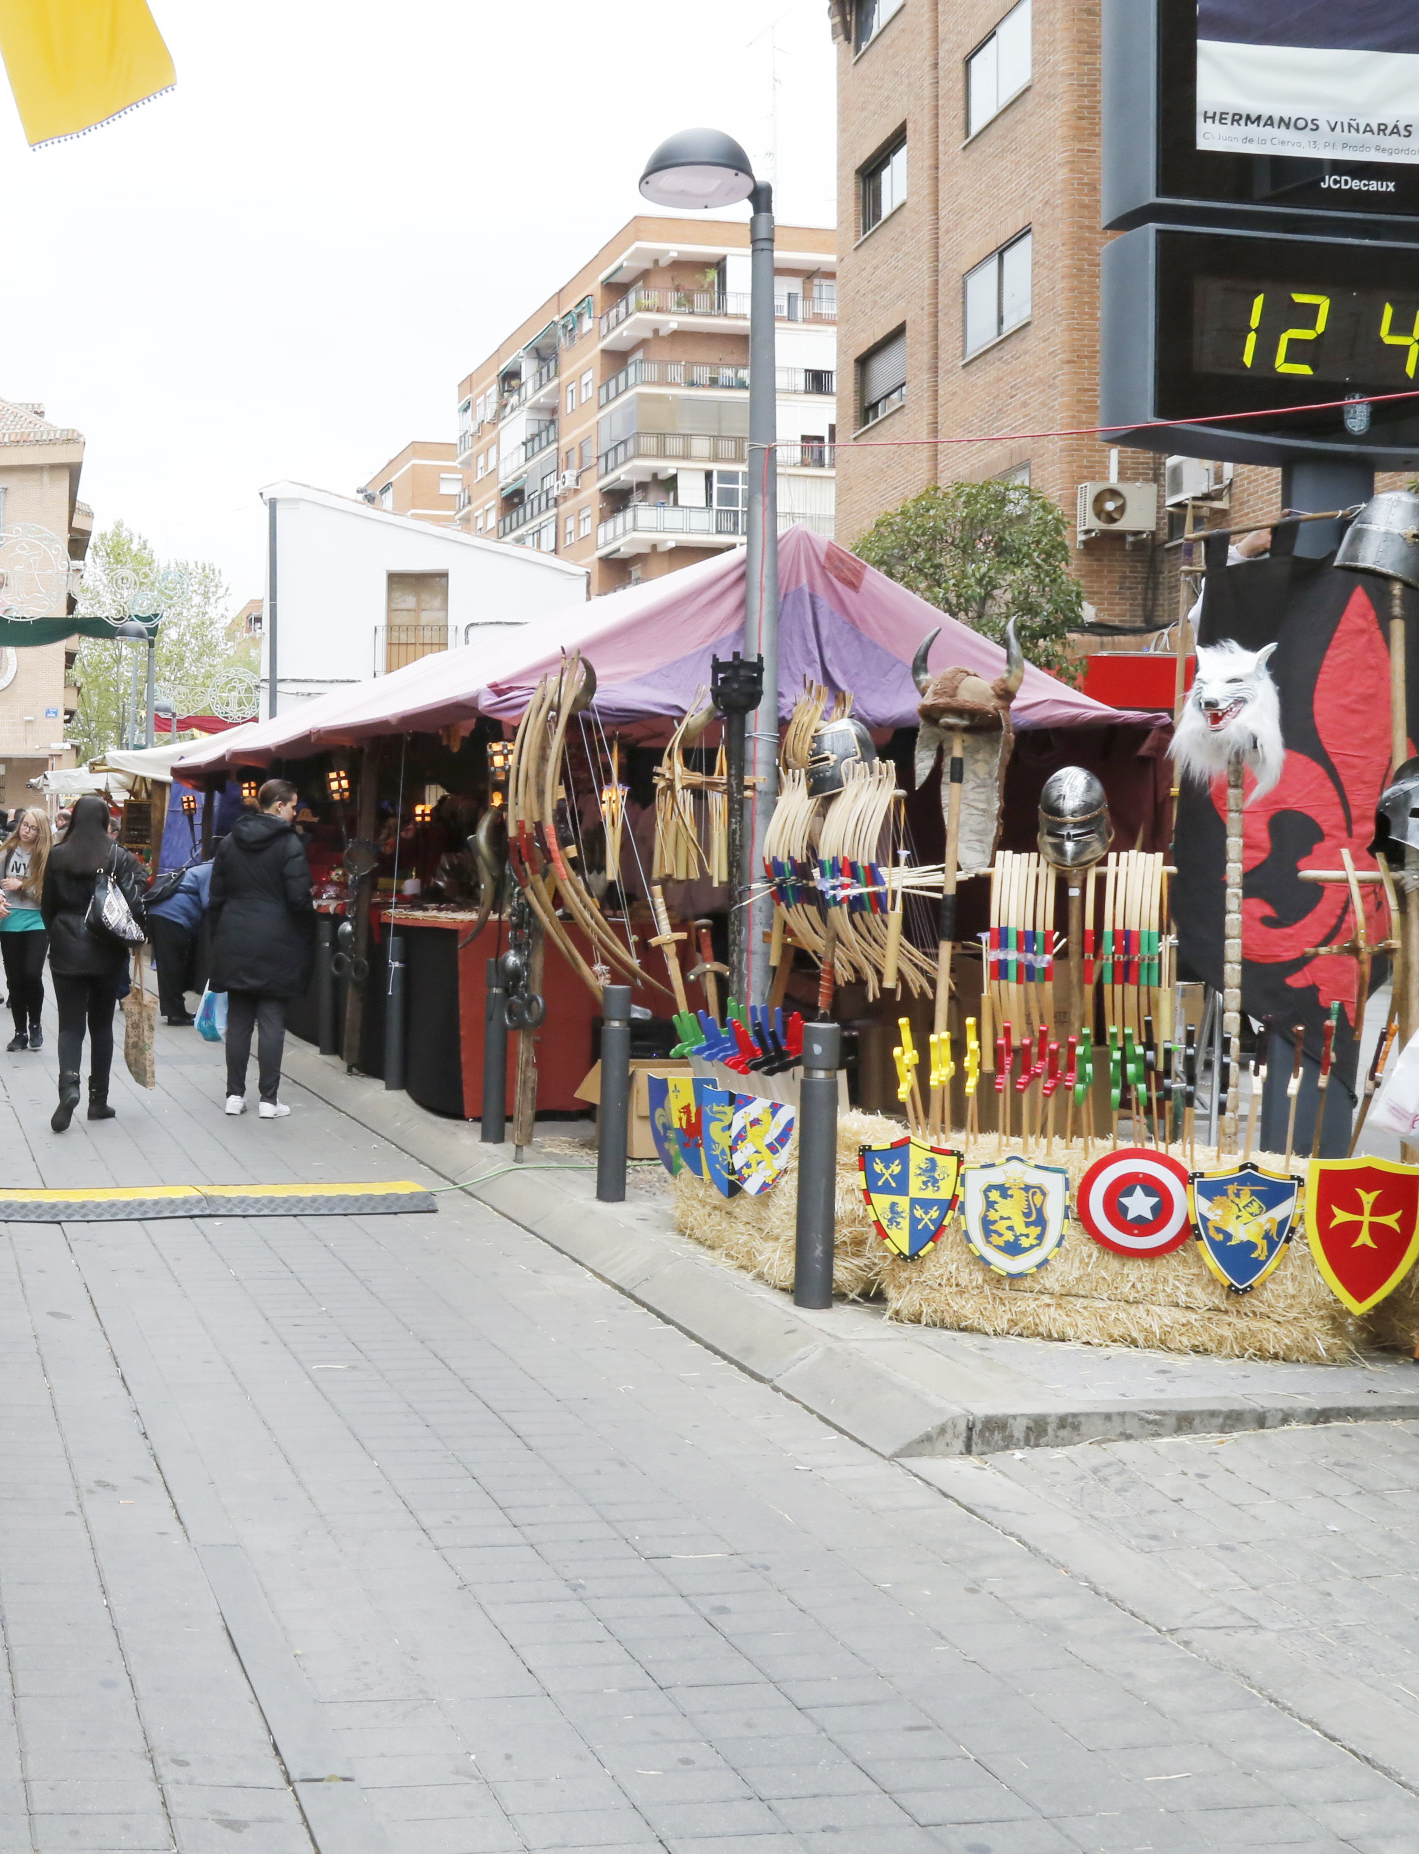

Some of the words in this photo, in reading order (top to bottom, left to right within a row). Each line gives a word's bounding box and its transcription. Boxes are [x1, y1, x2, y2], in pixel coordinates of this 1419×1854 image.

[1202, 110, 1321, 132] HERMANOS
[1325, 117, 1414, 139] VIÑARÁS
[1217, 133, 1239, 144] Juan
[1241, 136, 1254, 145] de
[1257, 136, 1267, 146] la
[1270, 137, 1305, 150] Cierva,
[1341, 142, 1372, 153] Prado
[1320, 174, 1396, 193] JCDecaux
[1242, 292, 1331, 376] 12
